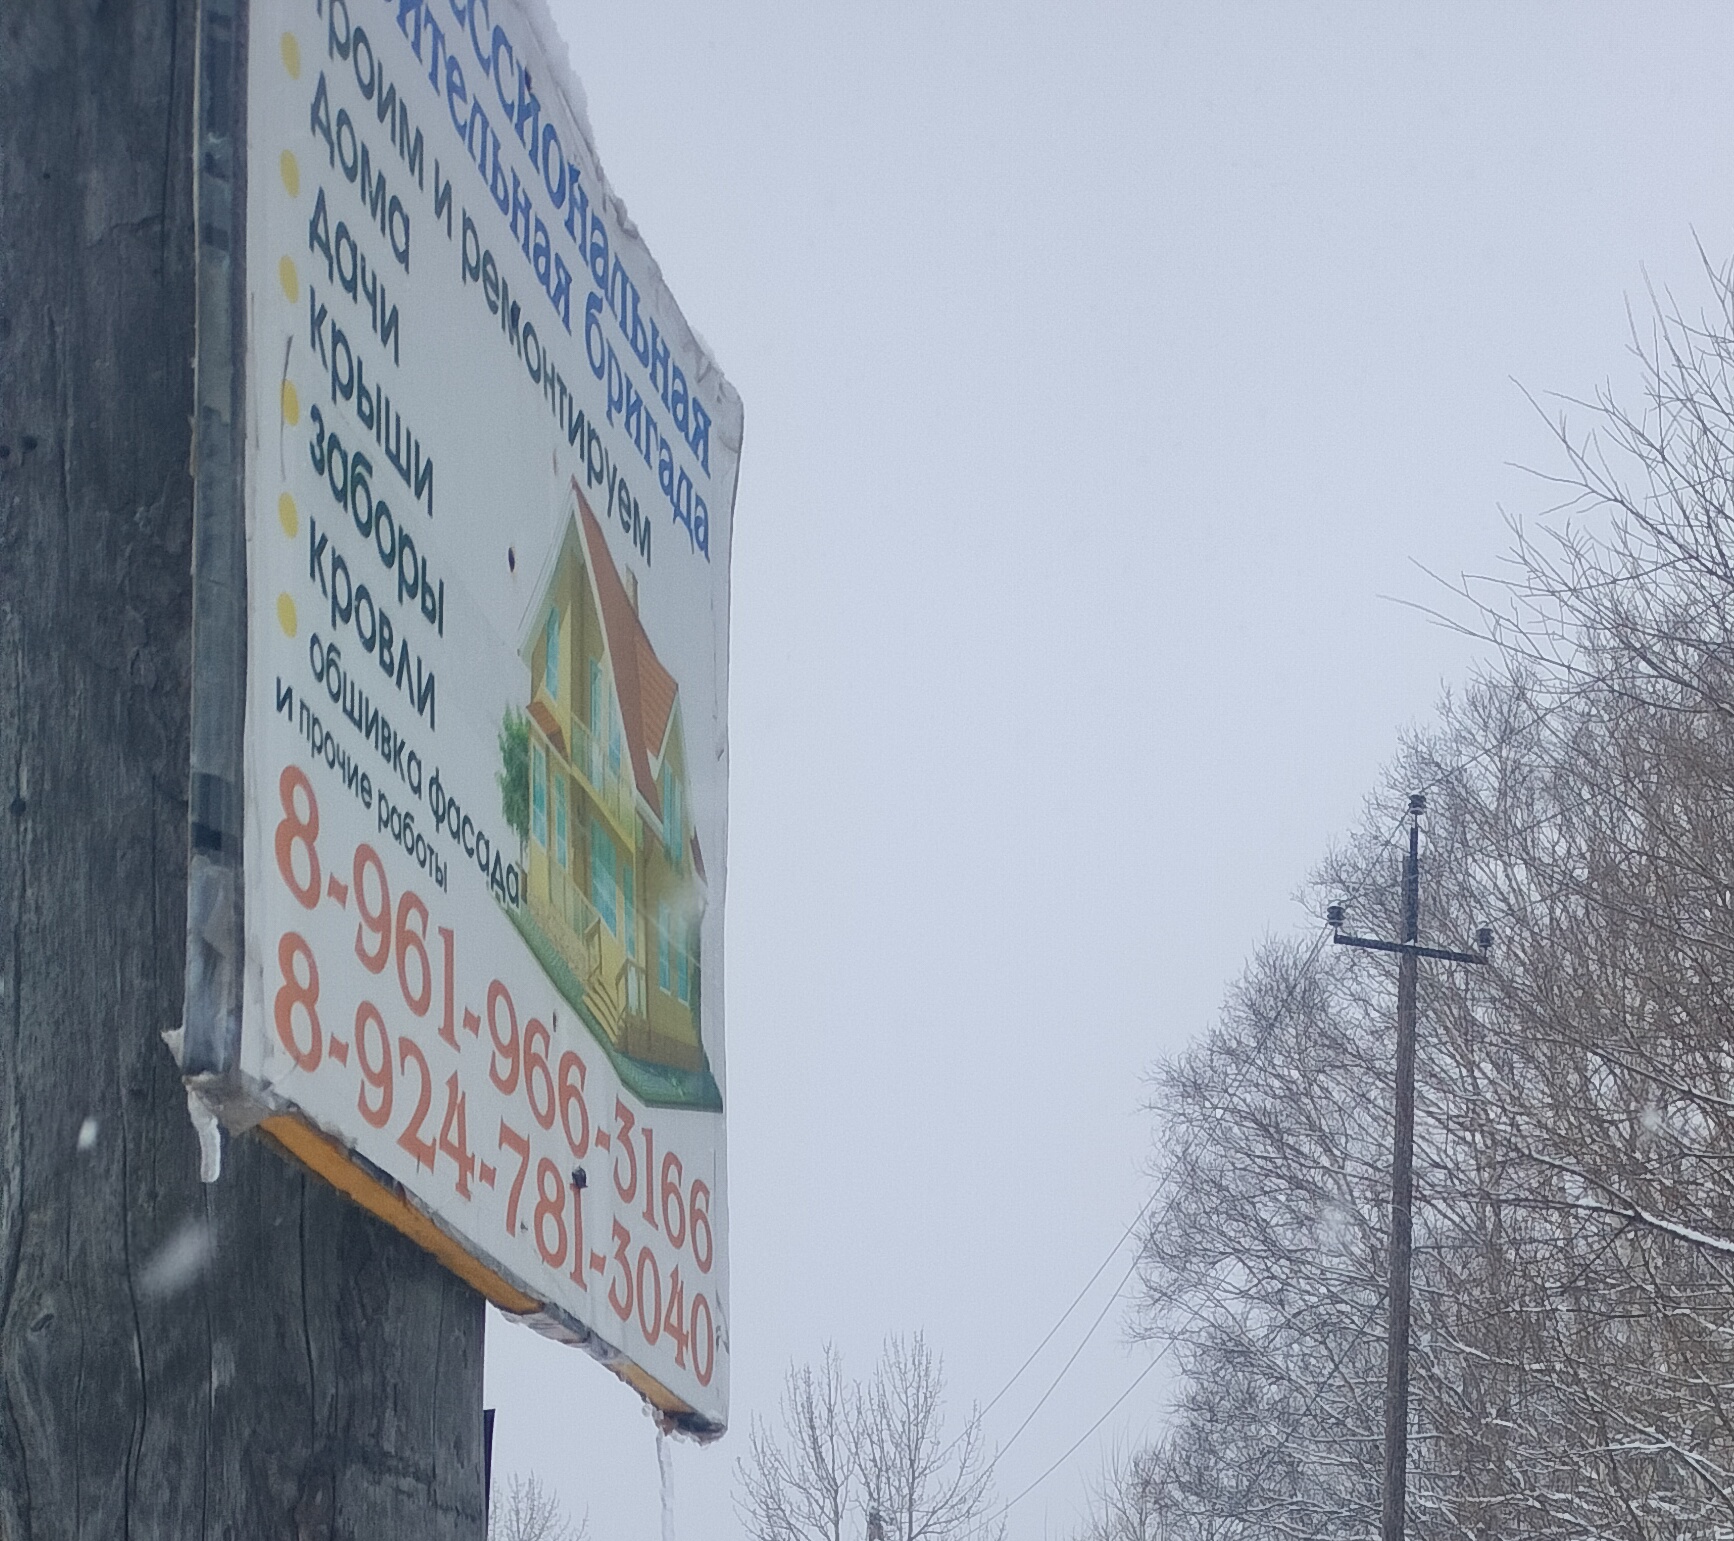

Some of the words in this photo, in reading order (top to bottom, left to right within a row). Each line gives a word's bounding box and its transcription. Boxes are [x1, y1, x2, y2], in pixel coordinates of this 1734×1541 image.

[309, 186, 399, 366] дачи
[310, 70, 410, 275] дома
[317, 0, 424, 193] роим
[435, 158, 452, 241] и
[462, 206, 651, 568] ремонтируем
[310, 284, 433, 518] крыши
[585, 292, 710, 563] бригада
[310, 404, 444, 638] заборы
[310, 515, 435, 732] кровли
[276, 676, 293, 722] и
[300, 698, 373, 810] прочие
[378, 789, 448, 894] работы
[309, 632, 422, 801] обшивка
[428, 766, 520, 908] фасада
[275, 764, 714, 1274] 8-961-966-3166
[275, 932, 714, 1386] 8-924-781-3040
